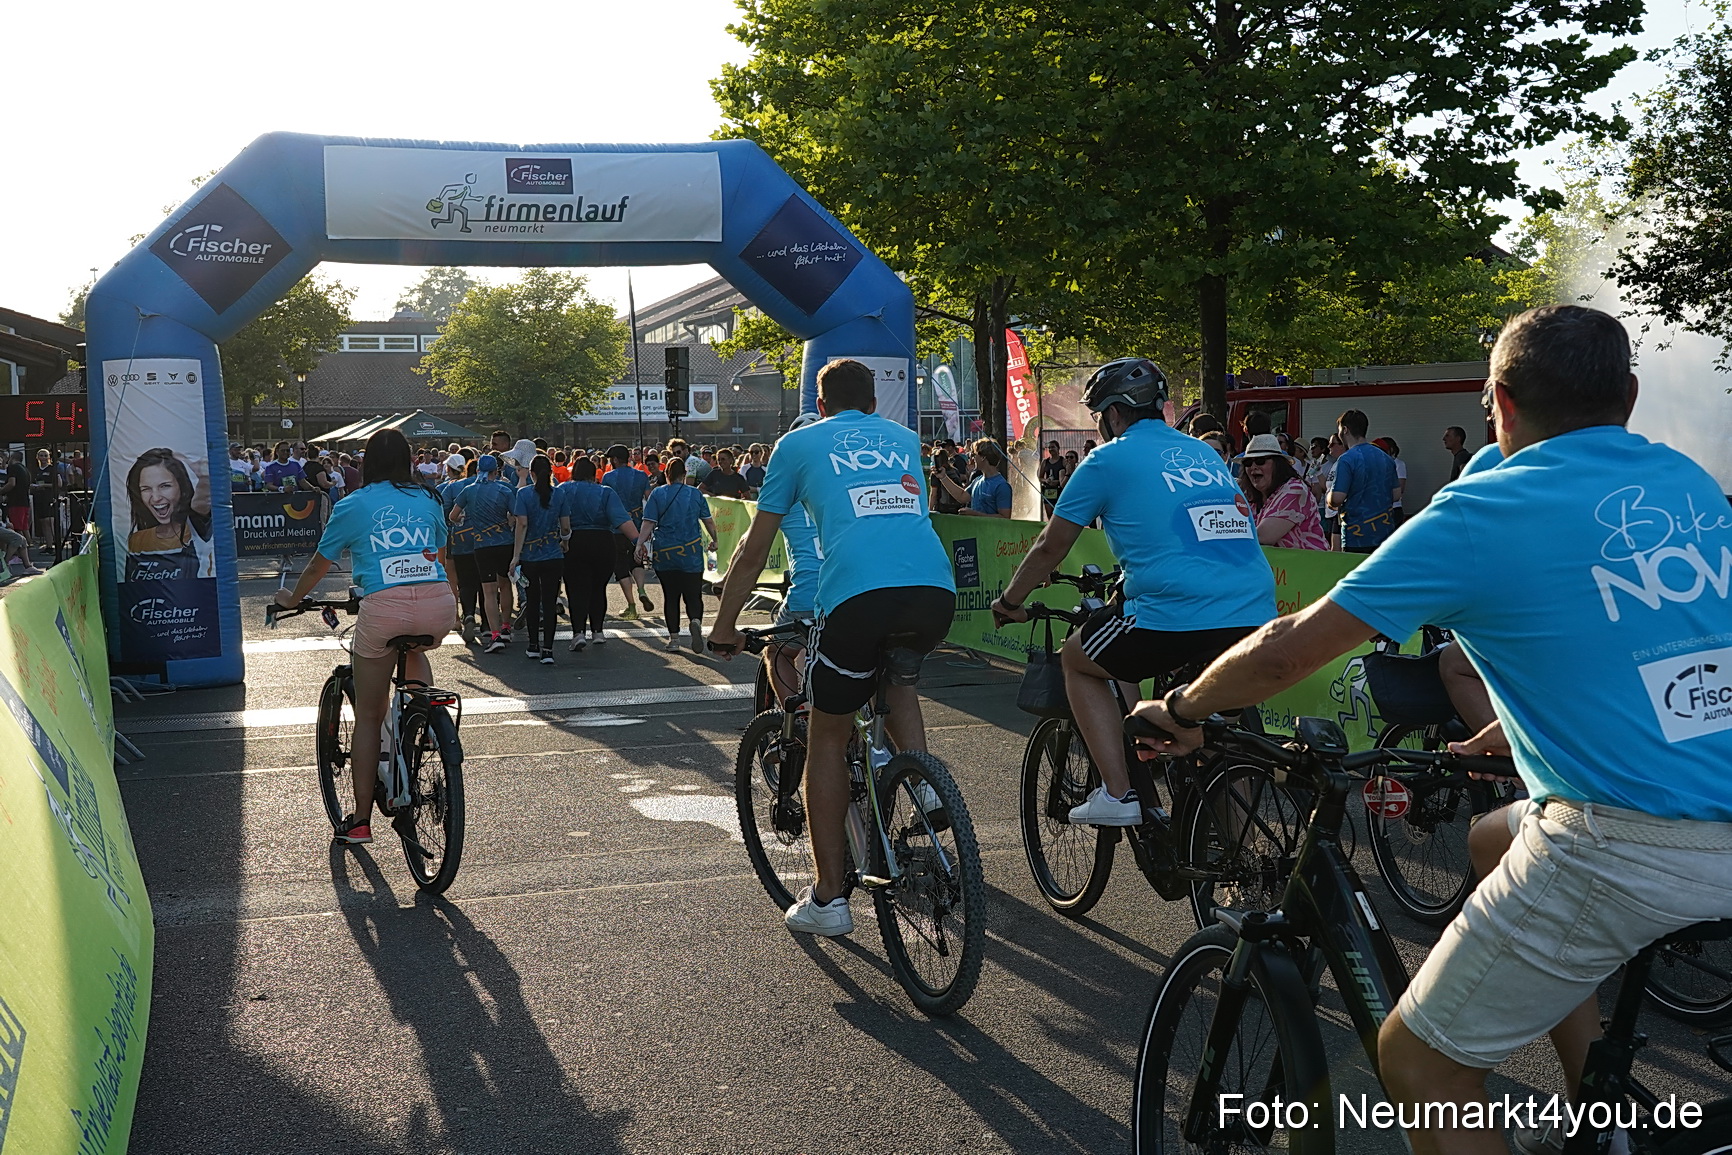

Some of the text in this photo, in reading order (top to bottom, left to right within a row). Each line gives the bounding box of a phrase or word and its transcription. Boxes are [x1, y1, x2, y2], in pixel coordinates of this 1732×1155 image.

[521, 170, 568, 181] Fischer
[485, 195, 629, 222] firmenlauf
[485, 224, 545, 233] neumarkt
[187, 238, 272, 255] Fischer
[790, 243, 809, 254] das
[195, 254, 265, 264] AUTOMOBILE
[639, 390, 663, 401] Hal
[832, 428, 902, 453] Bike
[829, 450, 910, 475] NOW
[1160, 446, 1221, 471] Bike
[1161, 467, 1236, 493] NOW
[869, 496, 916, 506] Fischer
[234, 514, 286, 529] mann
[372, 505, 424, 533] Bike
[1209, 518, 1248, 529] Fischer
[1594, 485, 1732, 562] Bike
[244, 528, 316, 539] Druck und Medien
[369, 526, 430, 552] NOW
[958, 554, 975, 564] Fischer
[395, 564, 433, 575] Fischer
[956, 580, 1003, 610] rmenlauf
[142, 607, 199, 620] Fischer
[147, 618, 195, 626] AUTOMOBILE
[1632, 649, 1651, 661] EIN
[1688, 686, 1732, 711] Fisc
[1257, 701, 1297, 731] falz.de
[1345, 951, 1388, 1029] HAI
